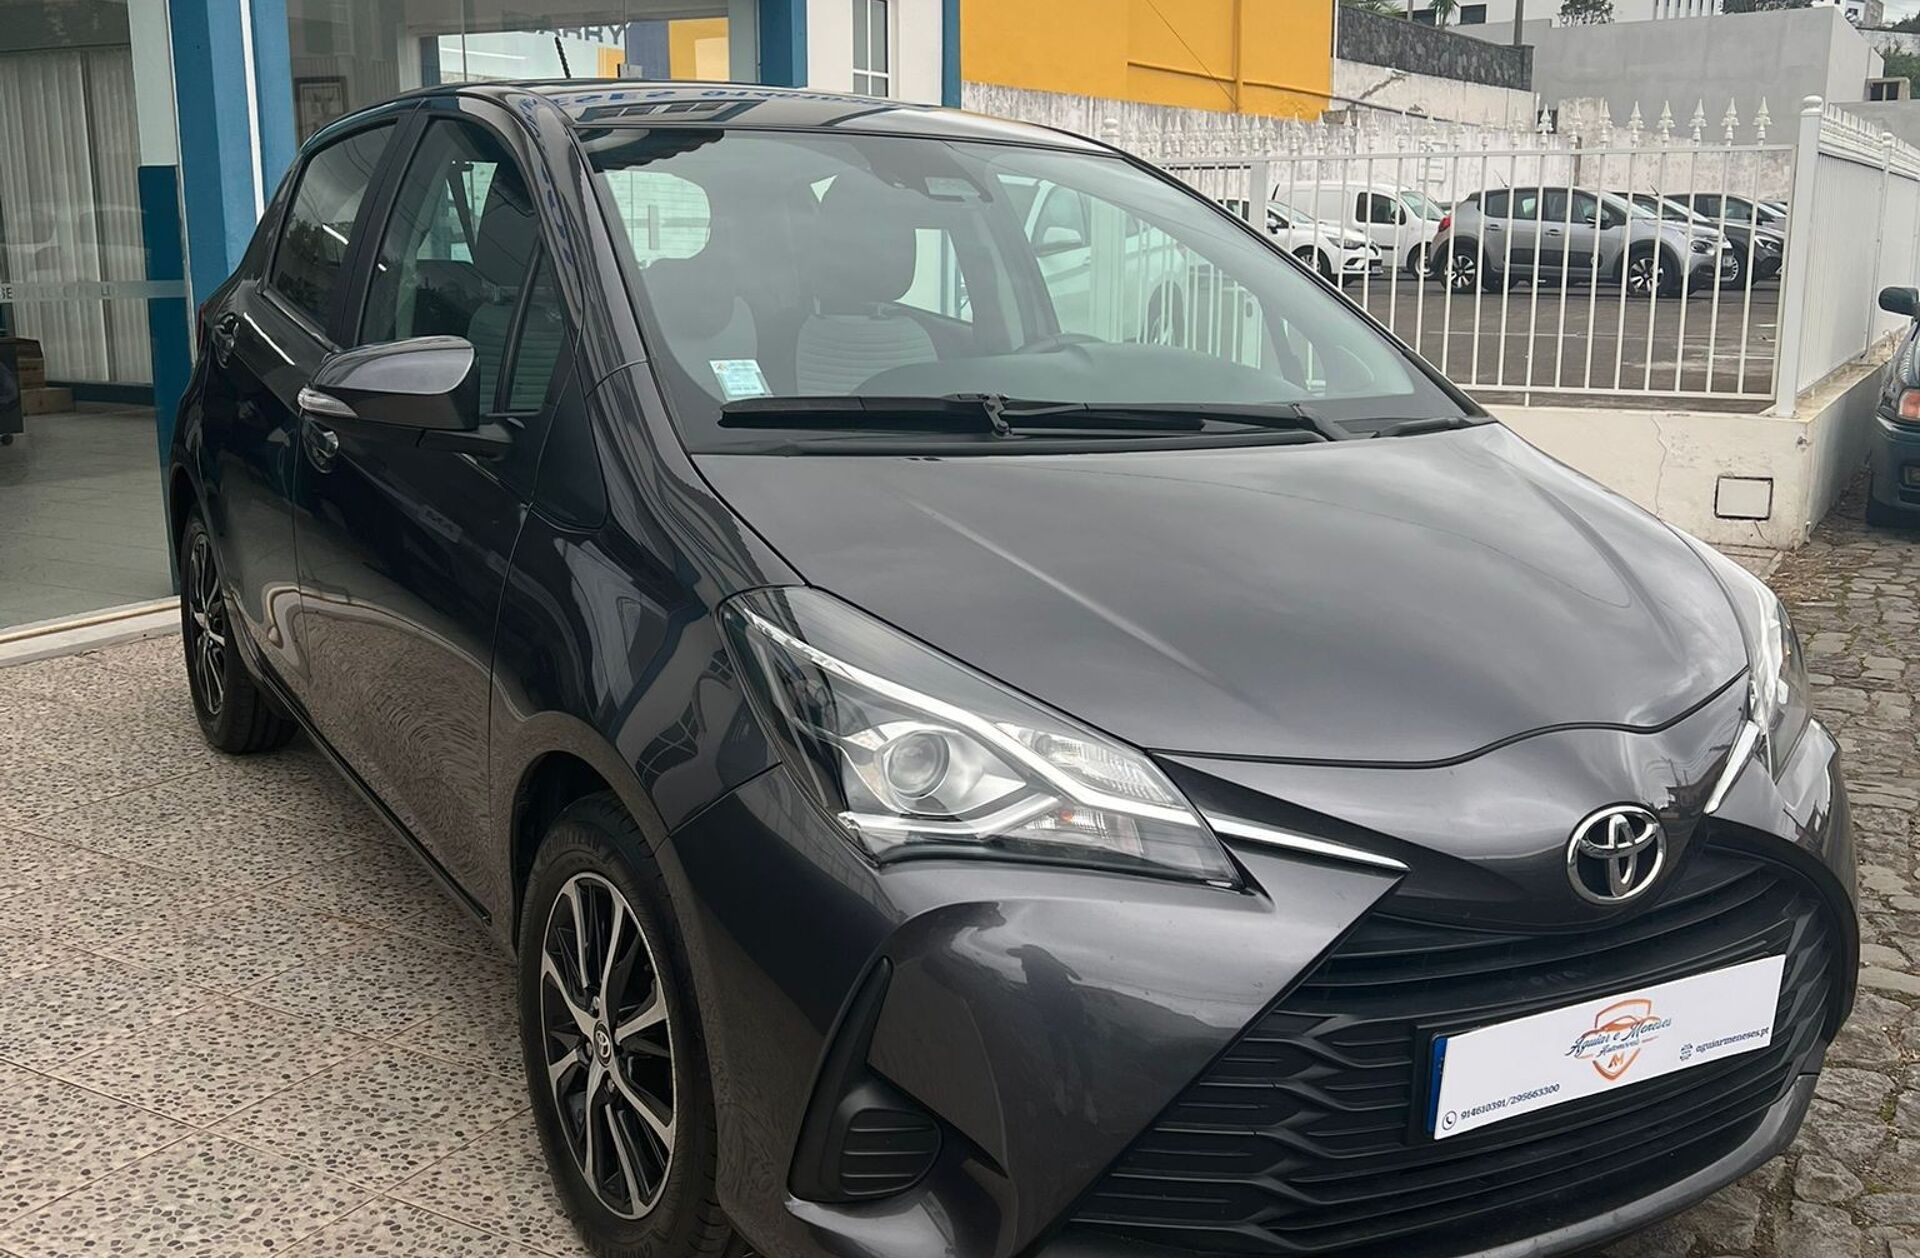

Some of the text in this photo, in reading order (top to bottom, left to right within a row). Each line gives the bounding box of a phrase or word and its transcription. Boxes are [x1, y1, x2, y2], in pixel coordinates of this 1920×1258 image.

[1564, 1032, 1611, 1059] Aguiar
[1620, 1017, 1673, 1042] Meneses
[1695, 1026, 1770, 1053] aguiarmeneses.pt
